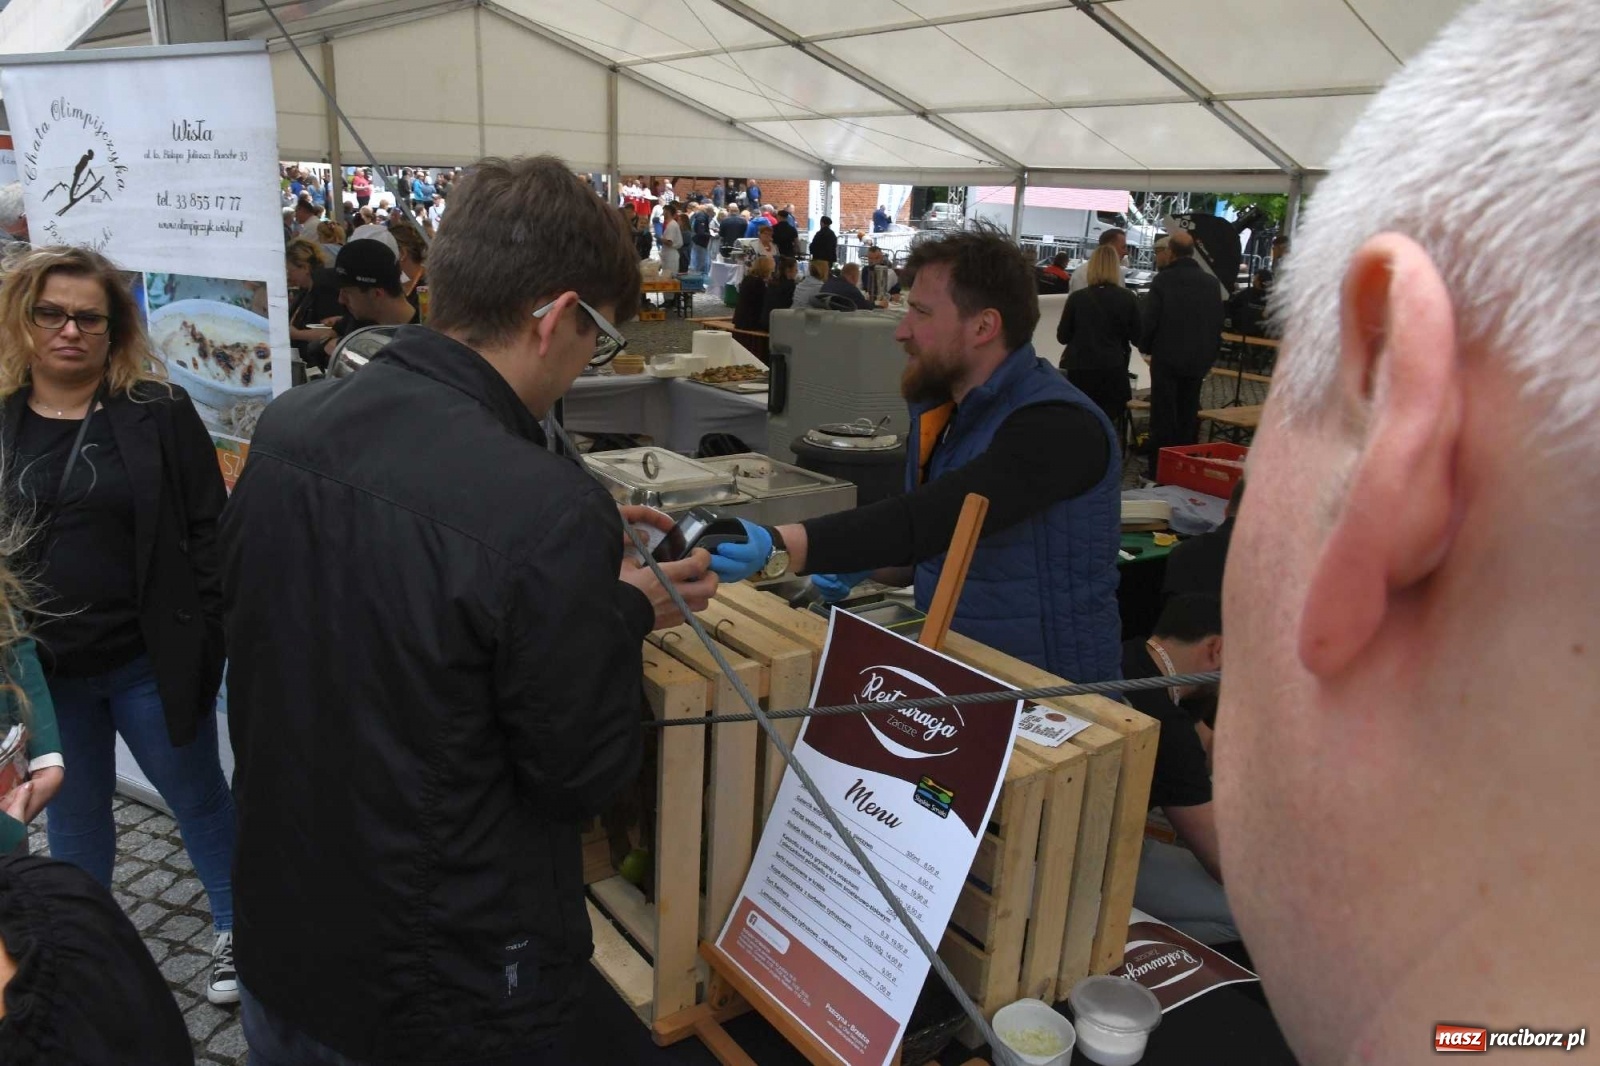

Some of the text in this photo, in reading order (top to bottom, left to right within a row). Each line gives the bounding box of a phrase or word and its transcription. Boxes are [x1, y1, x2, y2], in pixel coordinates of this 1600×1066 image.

[25, 122, 50, 186] Chata
[173, 119, 214, 141] Wisła
[157, 190, 241, 210] tel. 33 855 17 77
[862, 673, 957, 741] Resturacja
[844, 779, 902, 829] Menu
